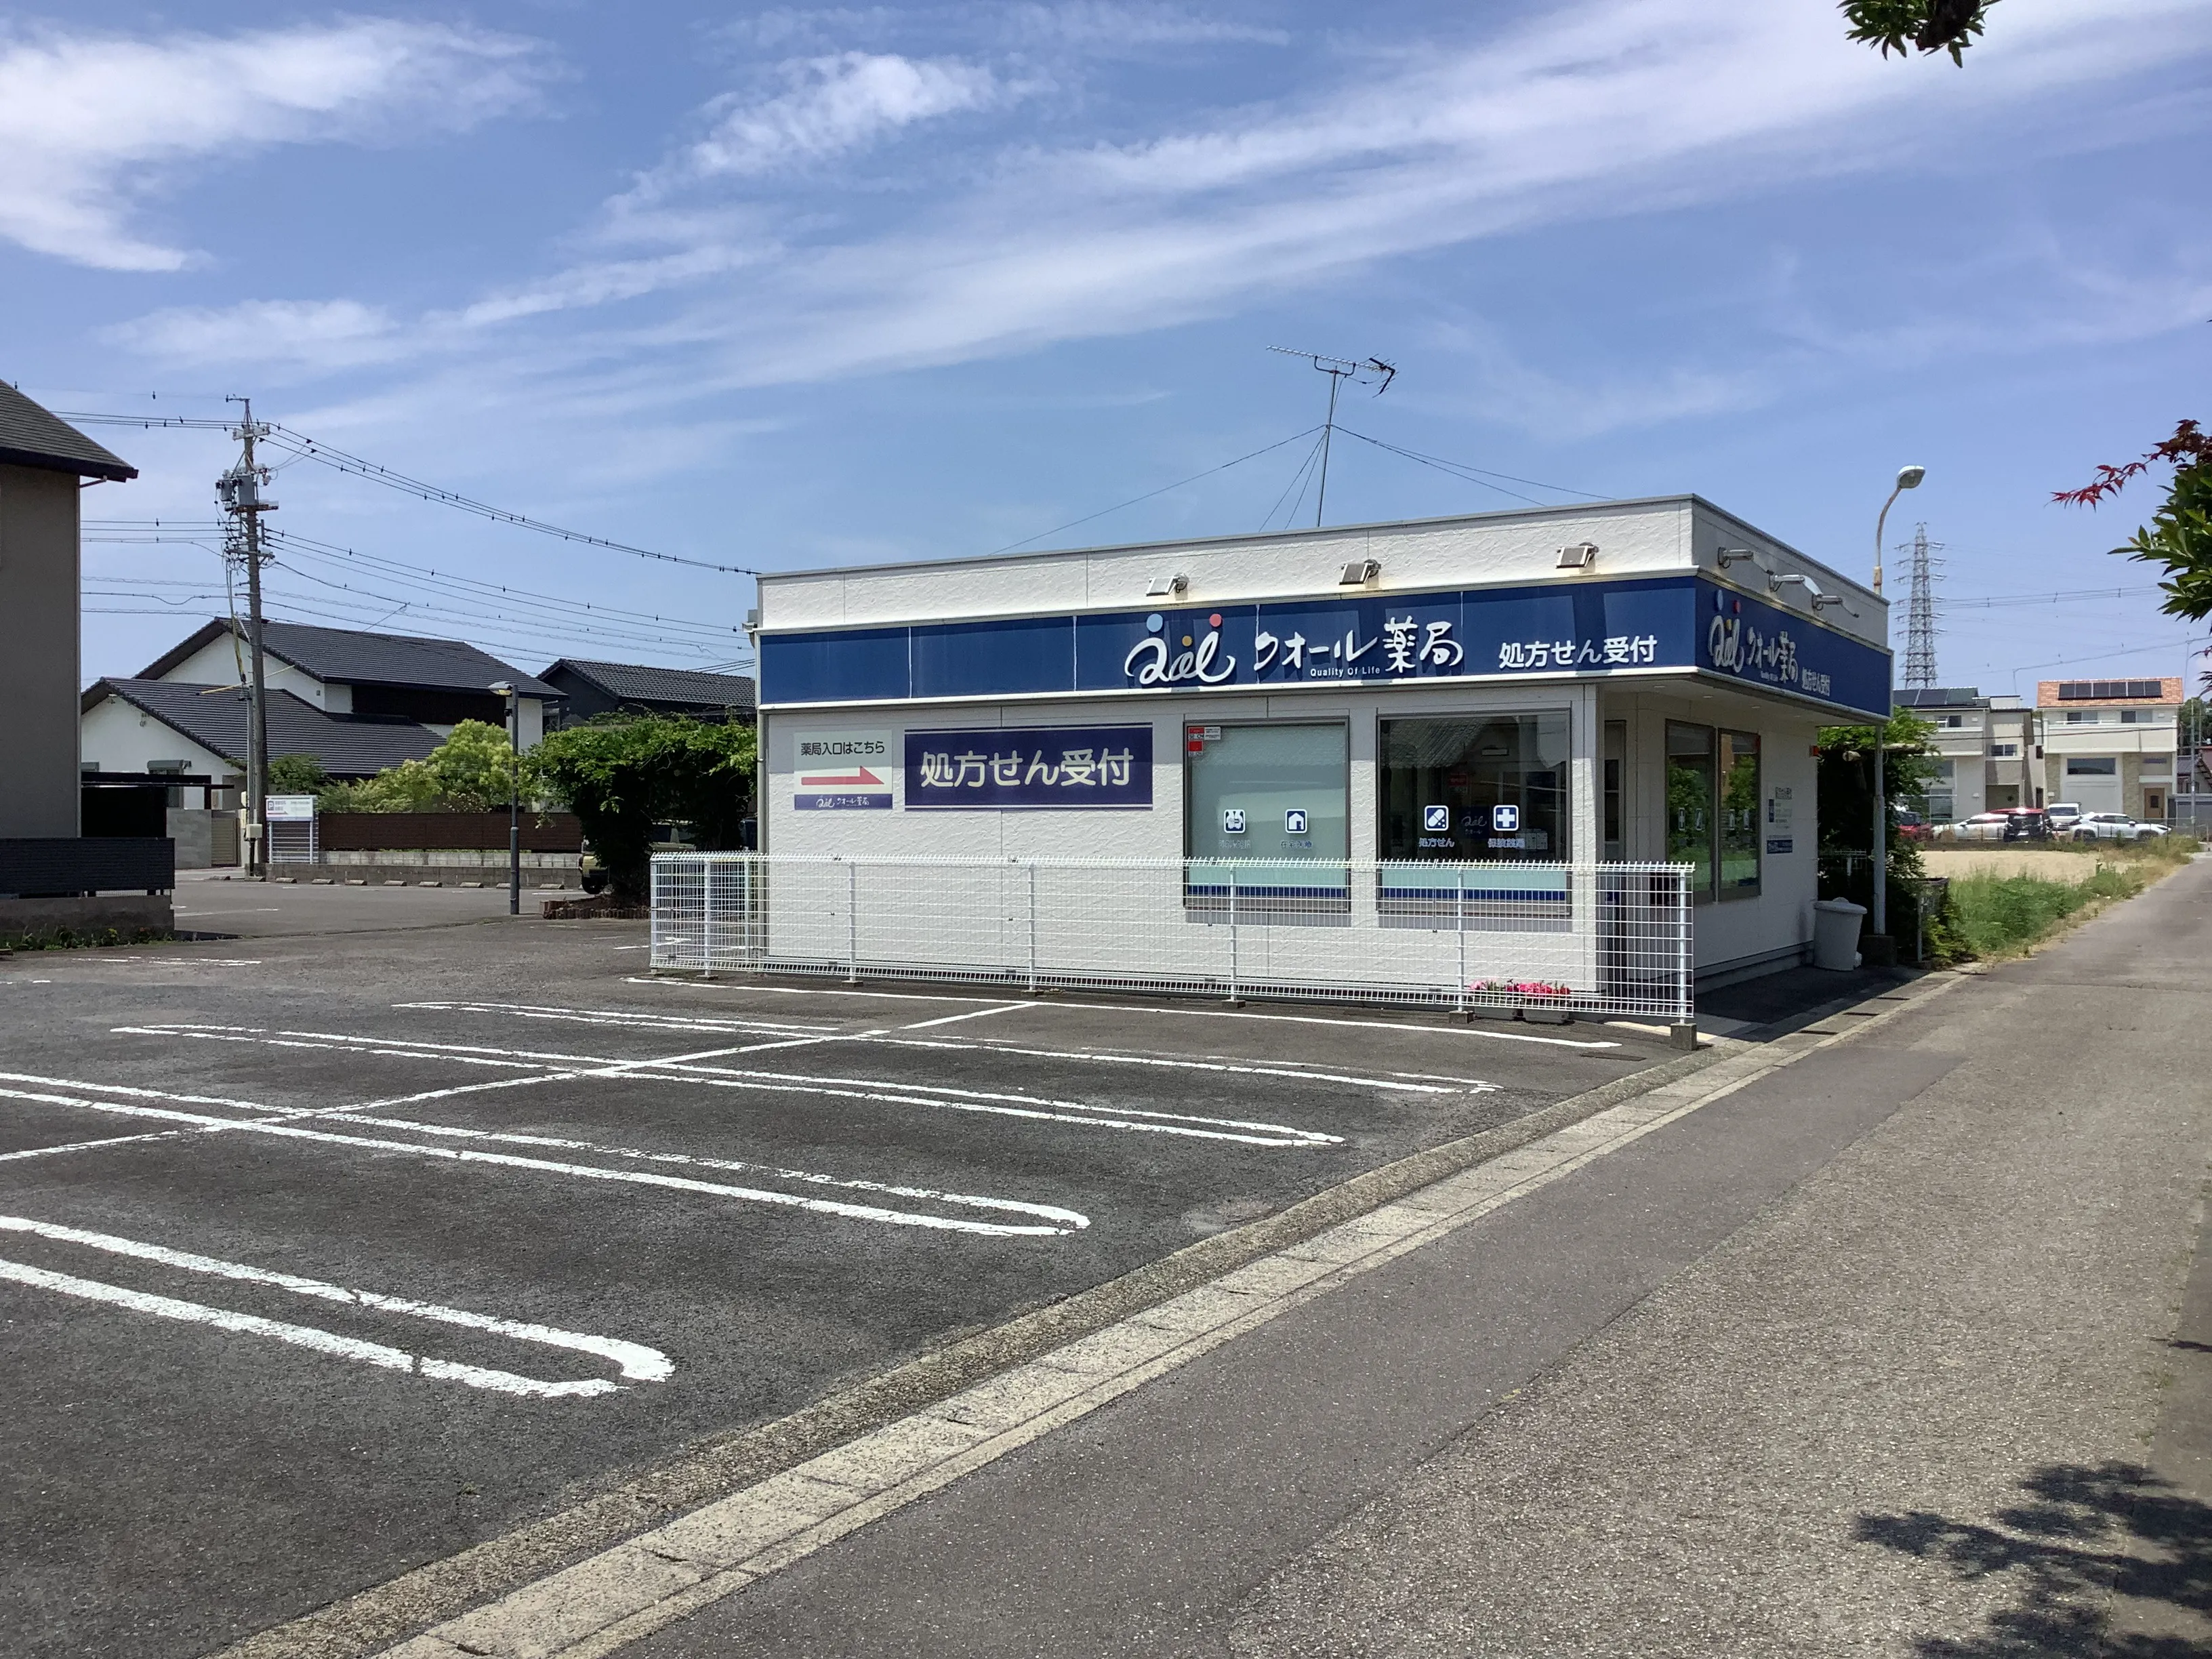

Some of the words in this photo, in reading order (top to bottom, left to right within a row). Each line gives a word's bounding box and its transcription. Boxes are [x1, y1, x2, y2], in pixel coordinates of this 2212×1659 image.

[1254, 615, 1464, 674] クオール薬局
[1498, 634, 1658, 669] 処方せん受付
[1310, 668, 1344, 677] Quality
[1347, 667, 1358, 676] Of
[1361, 665, 1380, 674] Life
[800, 741, 885, 756] 薬局入口はこちら
[920, 747, 1134, 787] 処方せん受付
[1418, 838, 1455, 848] 処方せん
